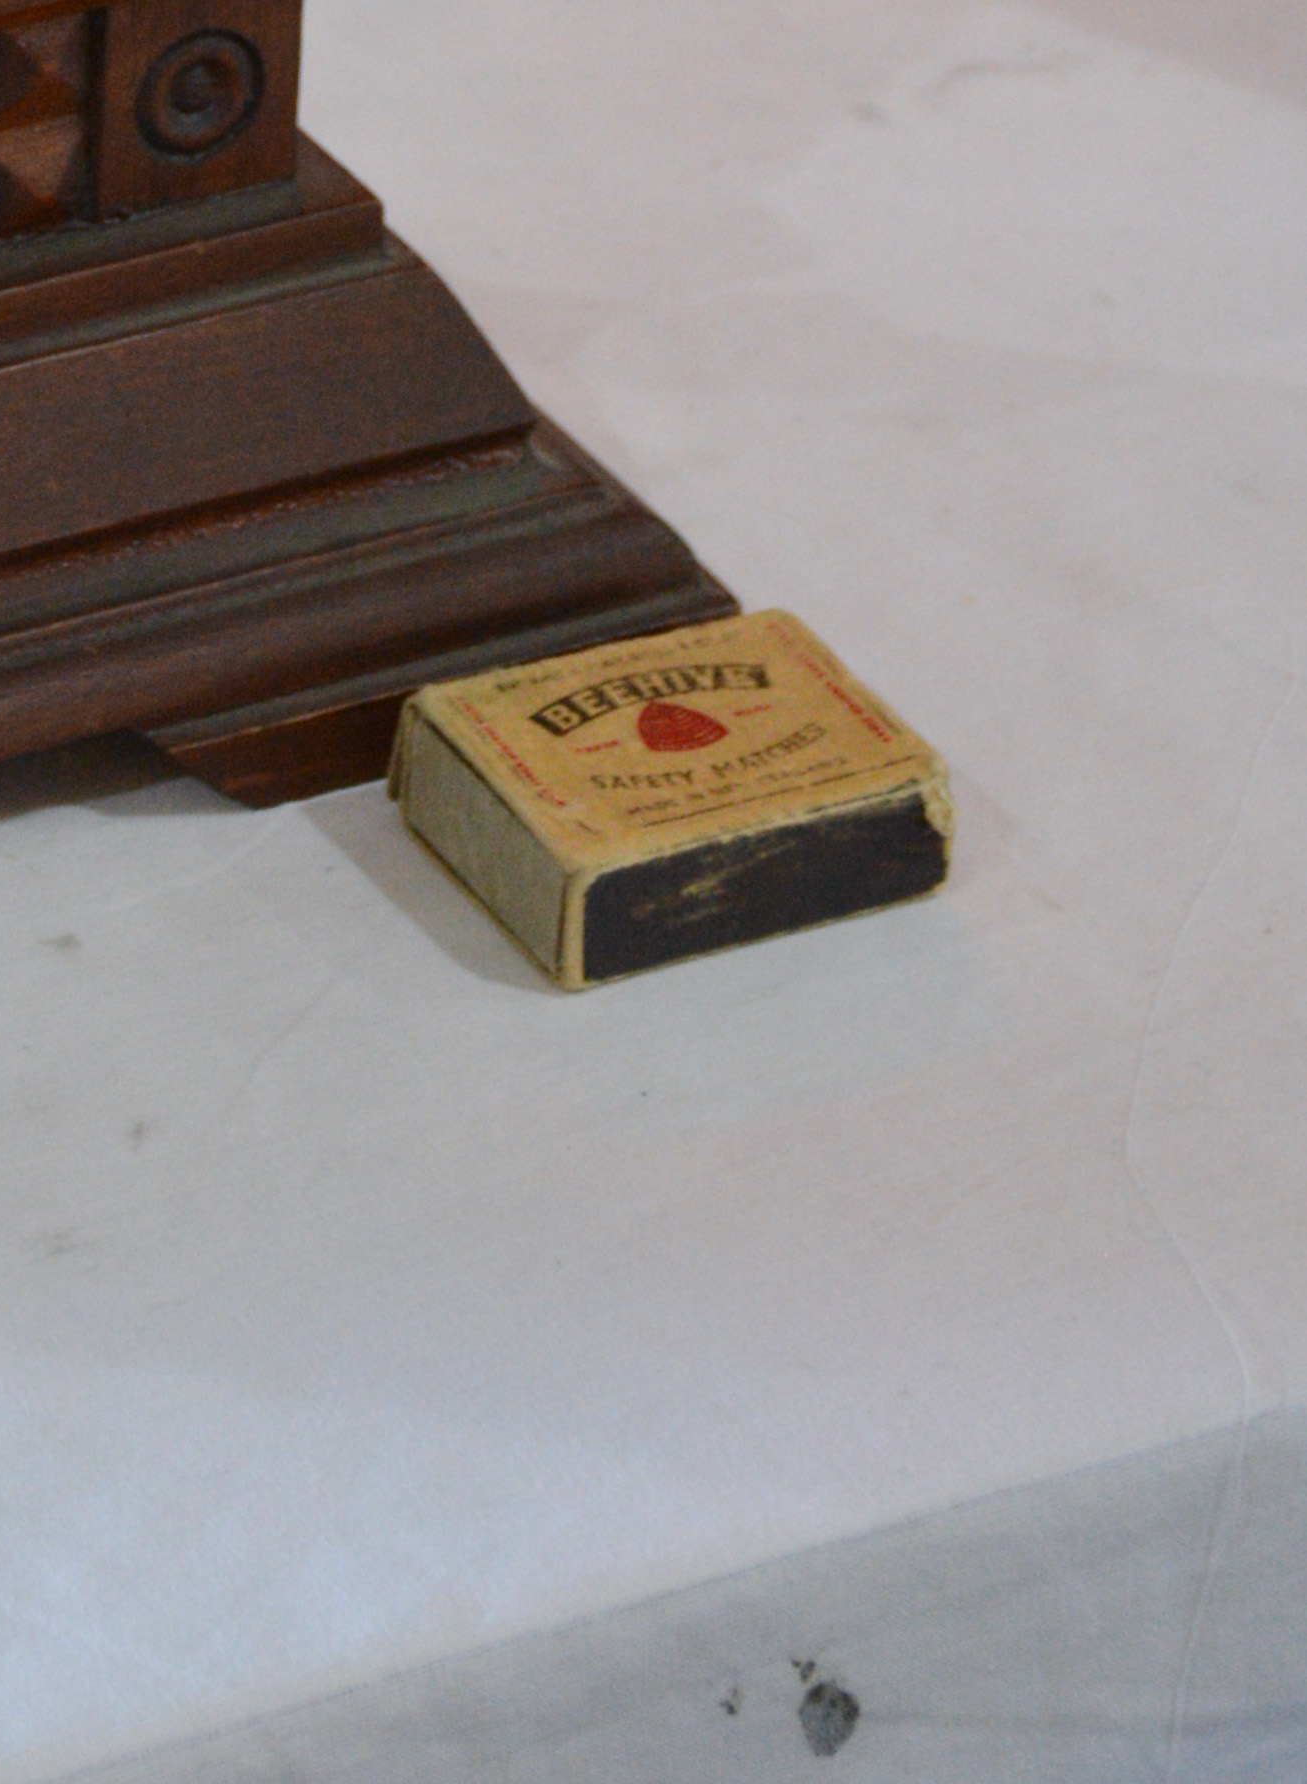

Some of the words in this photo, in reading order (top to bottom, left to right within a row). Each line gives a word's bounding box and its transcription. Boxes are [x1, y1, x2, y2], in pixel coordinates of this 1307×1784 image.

[535, 663, 765, 735] BEEHIVE
[589, 768, 696, 790] SAFETY
[709, 721, 828, 778] MATCHES
